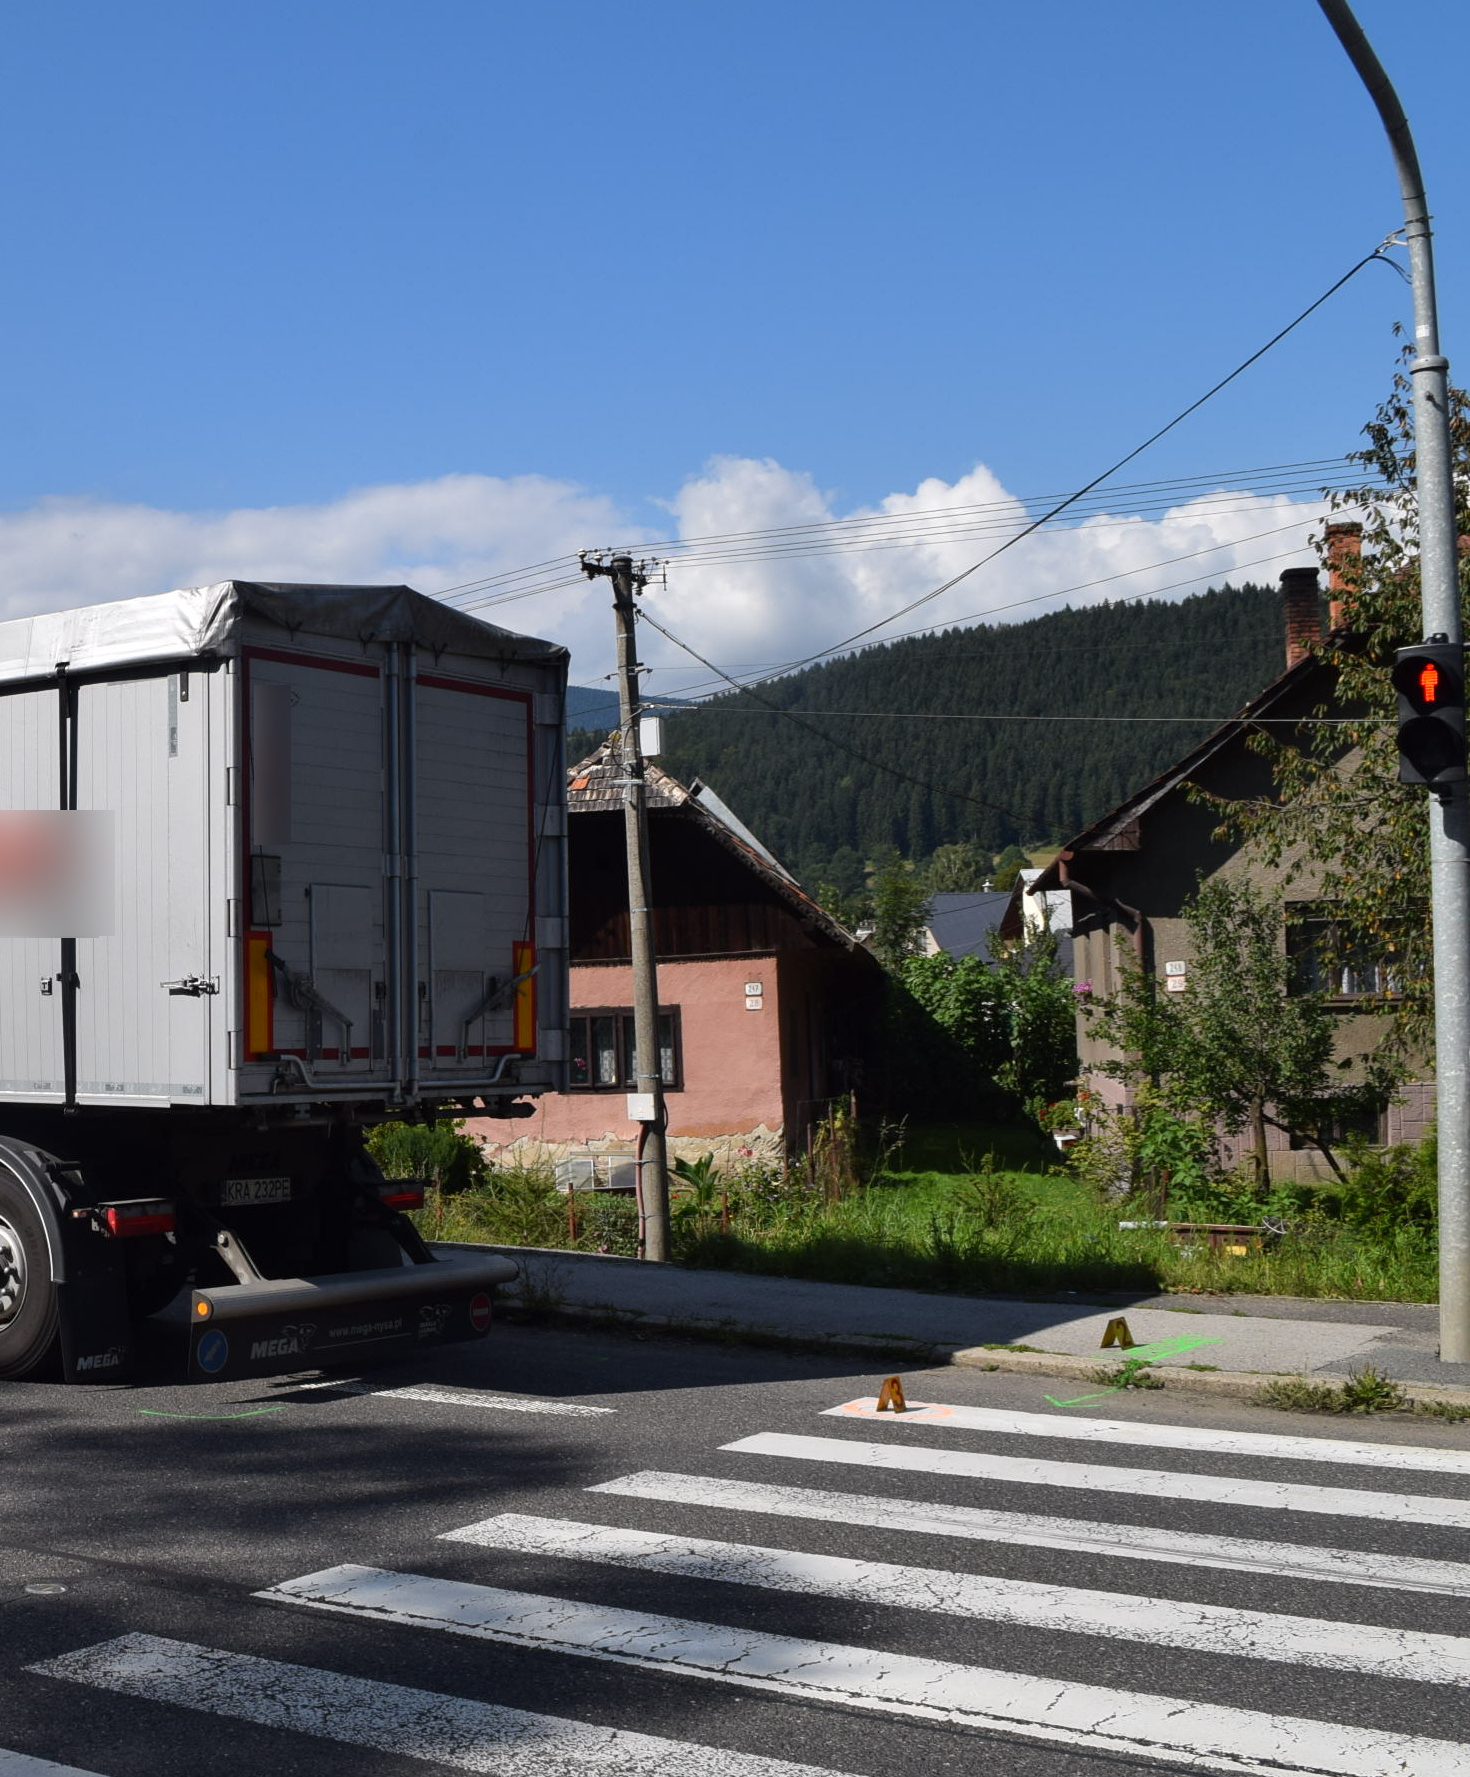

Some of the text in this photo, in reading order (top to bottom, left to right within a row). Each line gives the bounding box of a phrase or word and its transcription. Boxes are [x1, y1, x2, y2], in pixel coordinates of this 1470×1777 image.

[229, 1179, 289, 1200] KRA 232PE
[330, 1317, 403, 1338] www.mega-nysa.pl
[250, 1337, 299, 1360] MEGA
[76, 1353, 119, 1371] MEGA
